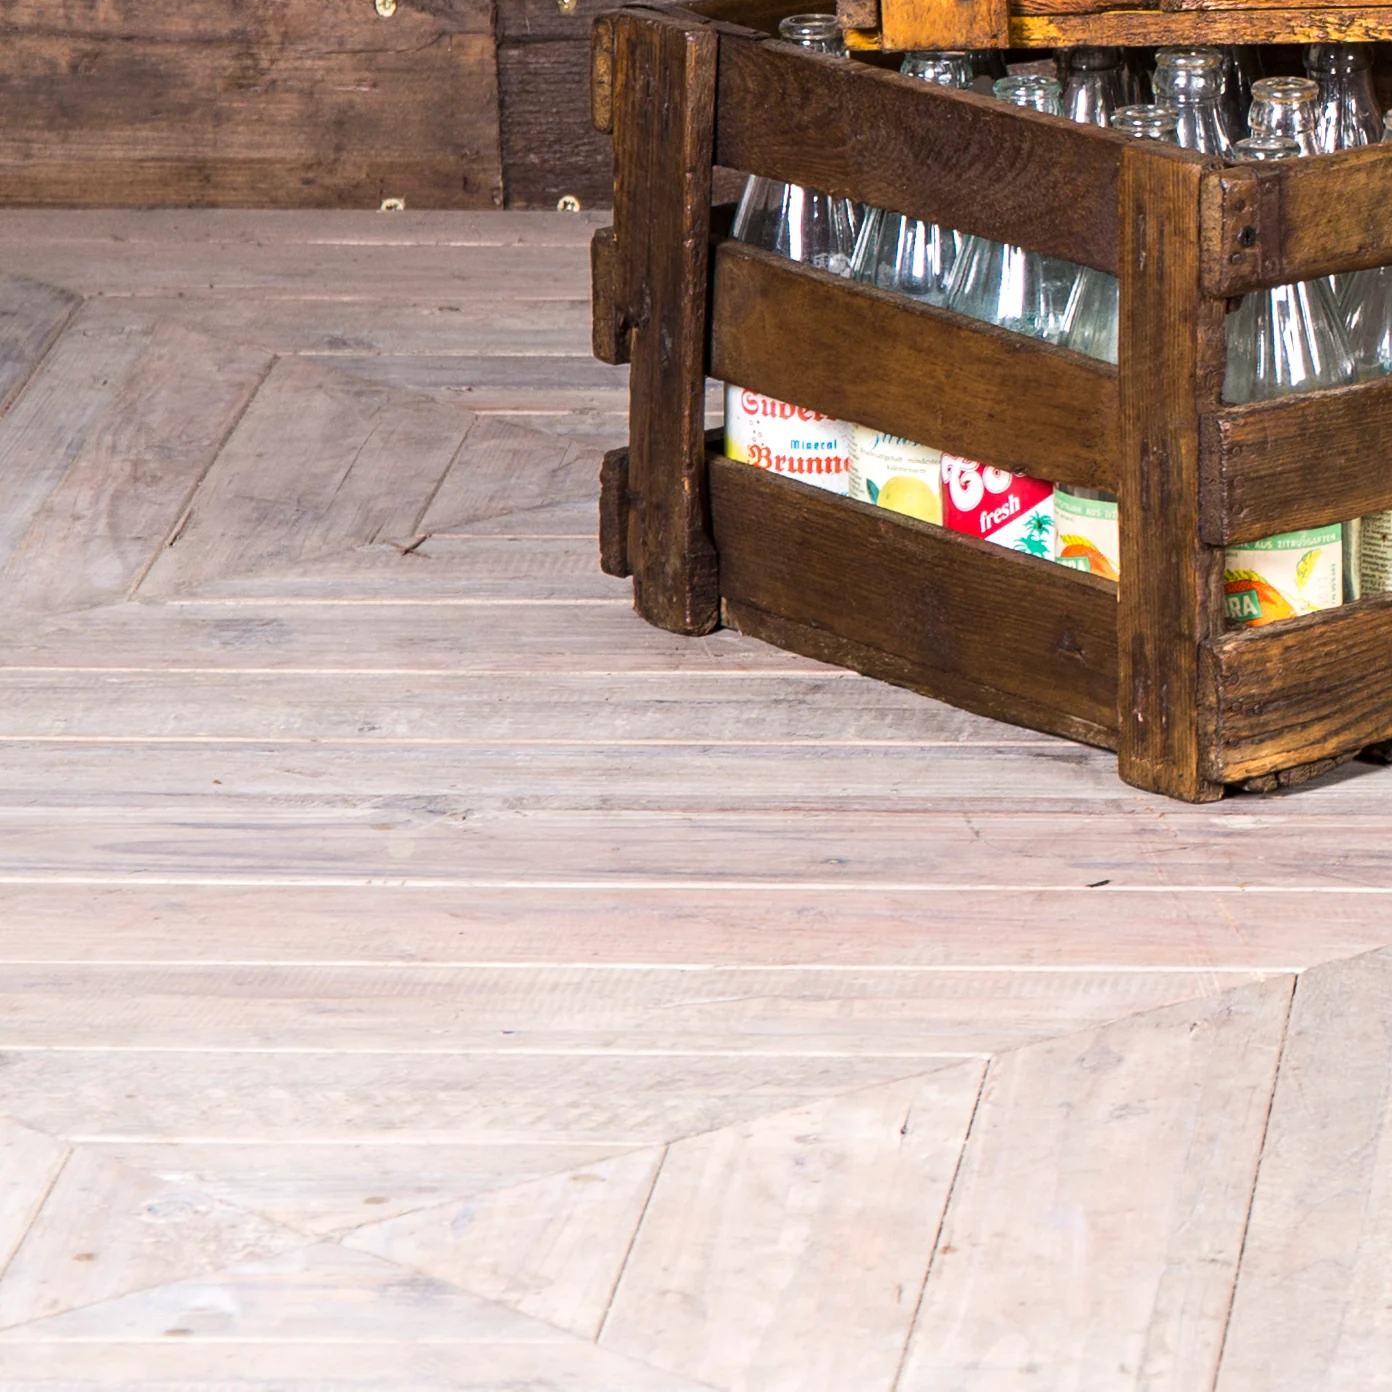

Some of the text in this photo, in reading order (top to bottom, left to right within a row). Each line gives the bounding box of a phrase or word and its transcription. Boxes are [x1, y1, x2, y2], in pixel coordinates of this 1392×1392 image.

[790, 438, 838, 451] Mineral
[979, 493, 1022, 534] fresh
[1225, 594, 1259, 618] RA
